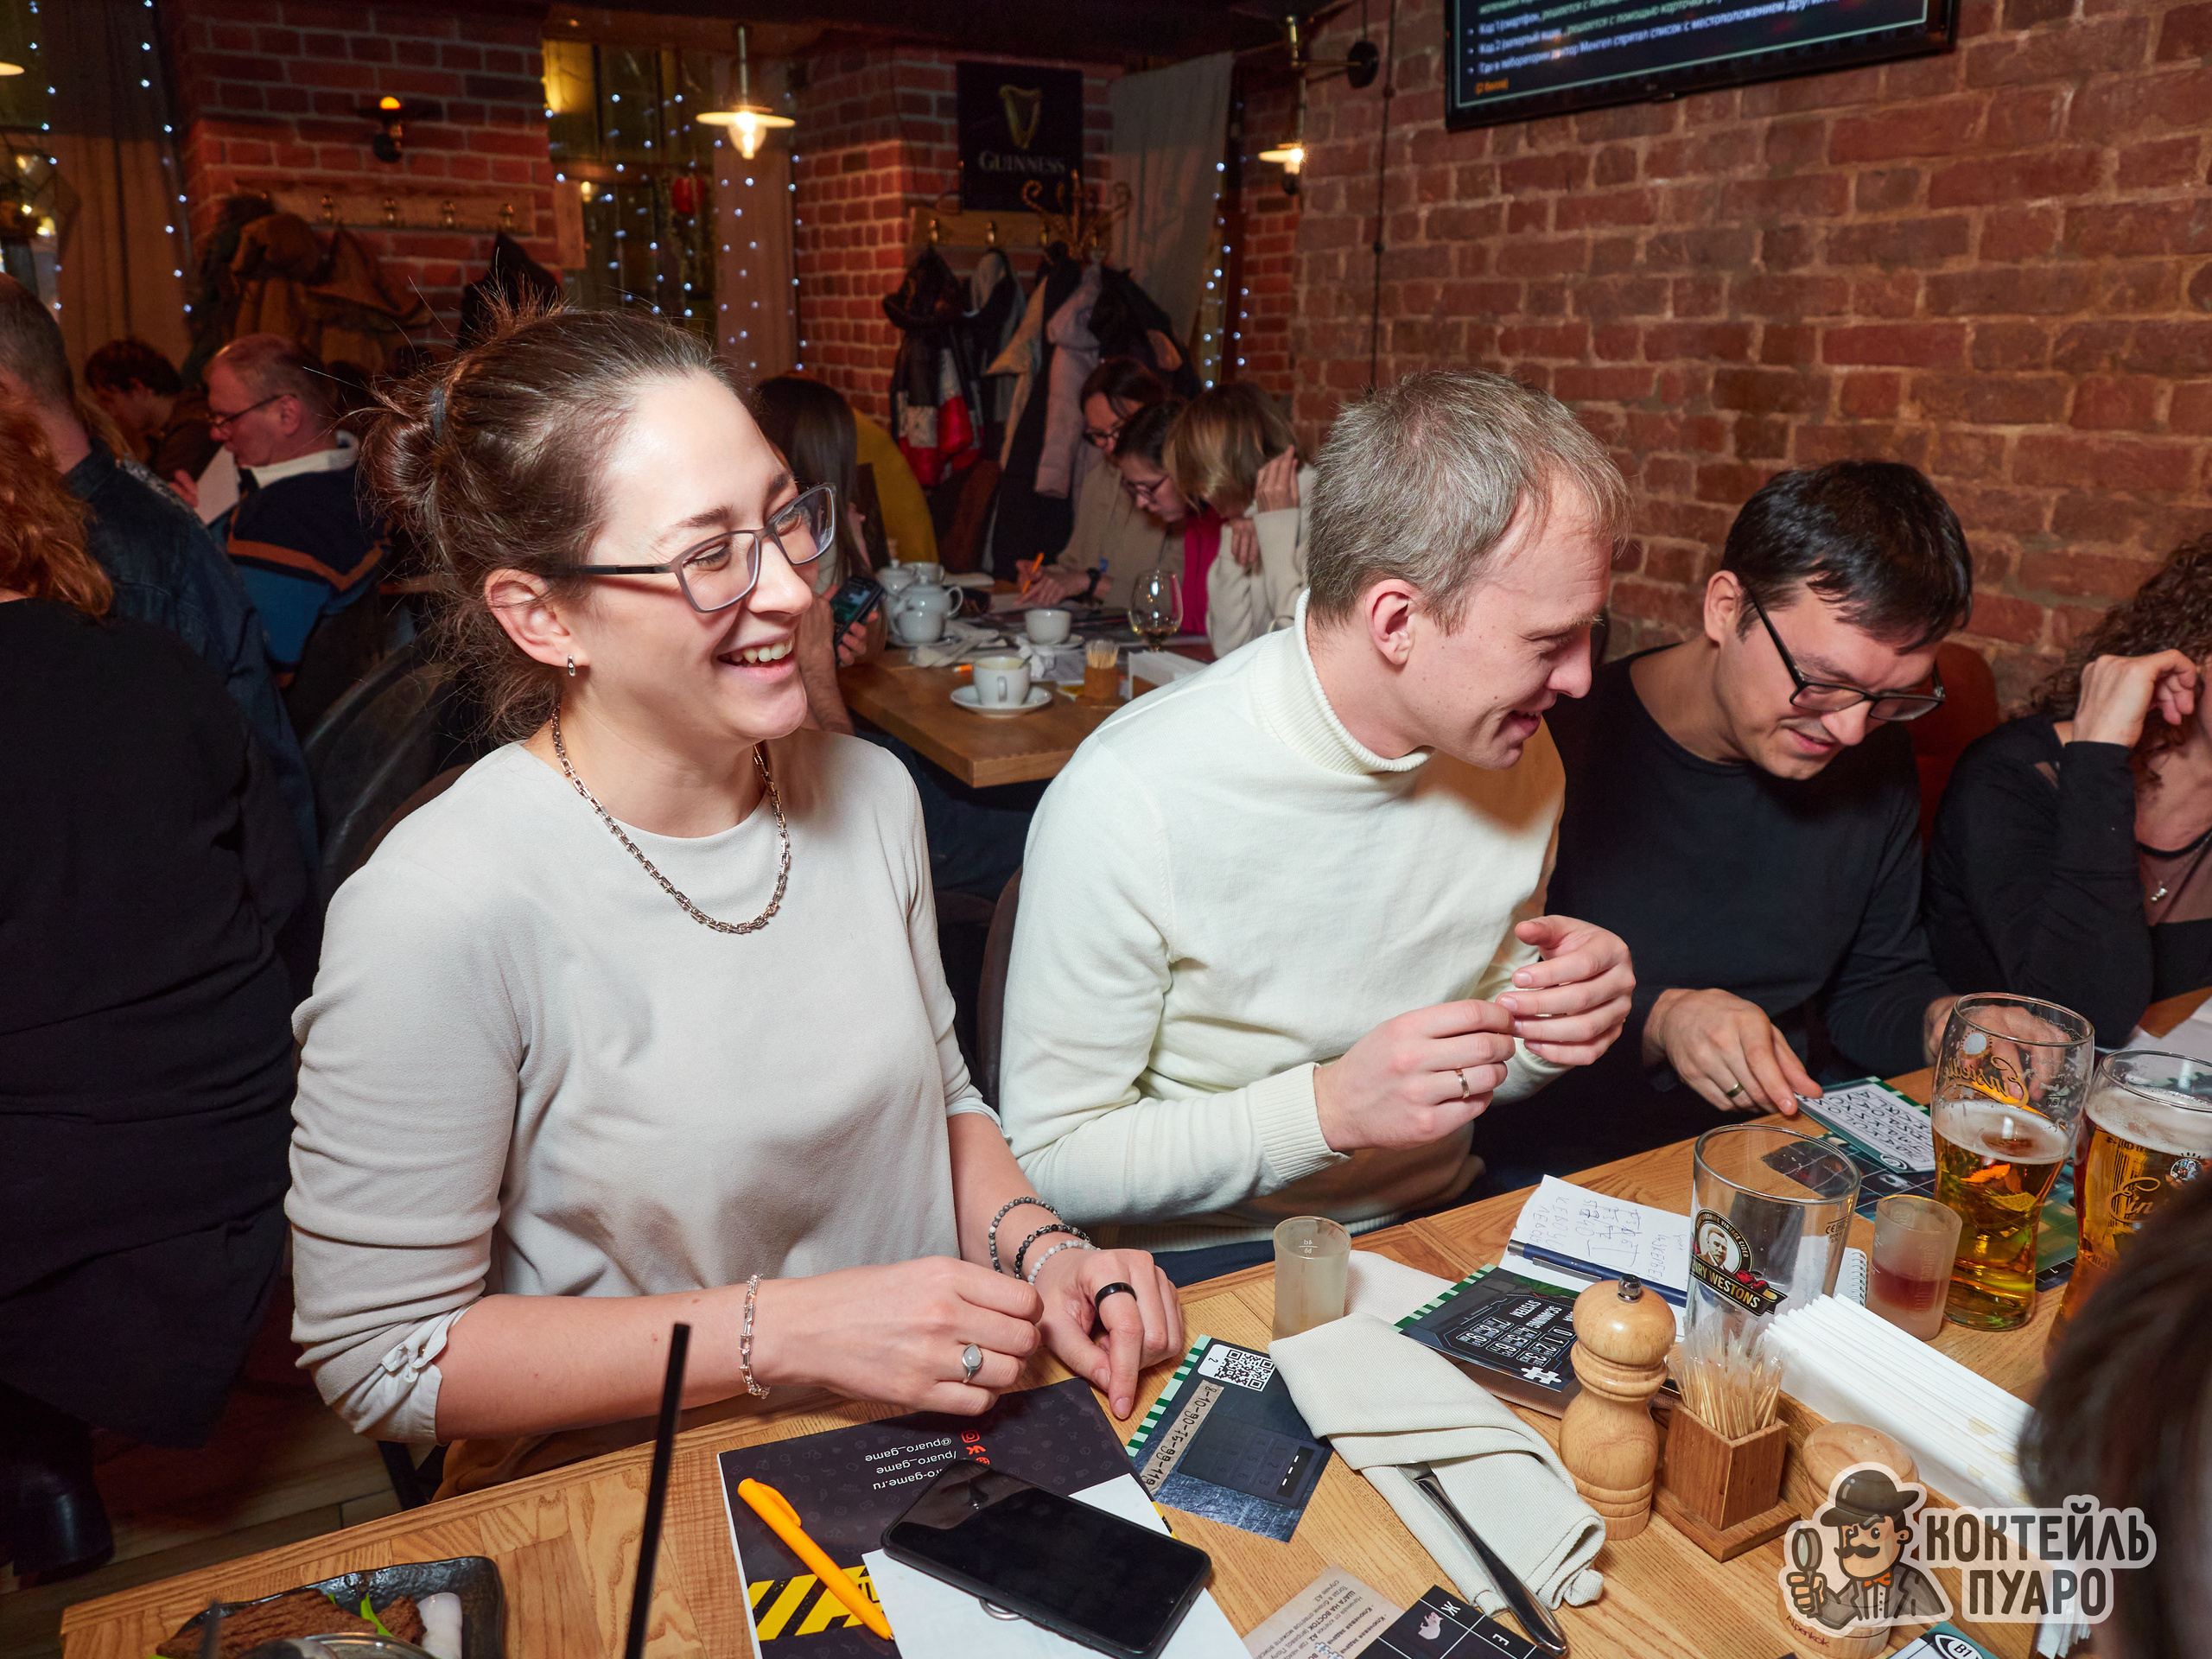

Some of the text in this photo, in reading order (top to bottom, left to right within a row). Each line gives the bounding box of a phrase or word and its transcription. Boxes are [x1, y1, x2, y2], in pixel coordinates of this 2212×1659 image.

[979, 150, 1065, 173] GUINNESS
[1709, 1270, 1761, 1309] WESTONS
[1510, 1300, 1541, 1318] SYSTEM
[1526, 1306, 1563, 1329] SCANNING
[865, 1438, 952, 1462] @puaro_game
[876, 1451, 957, 1474] /puaro_game
[1329, 1603, 1338, 1611] НА
[1338, 1589, 1354, 1605] ШАГА
[1440, 1600, 1461, 1617] Ж
[1308, 1610, 1330, 1630] ВОСТОК
[1786, 1615, 1830, 1648] Alpenkok
